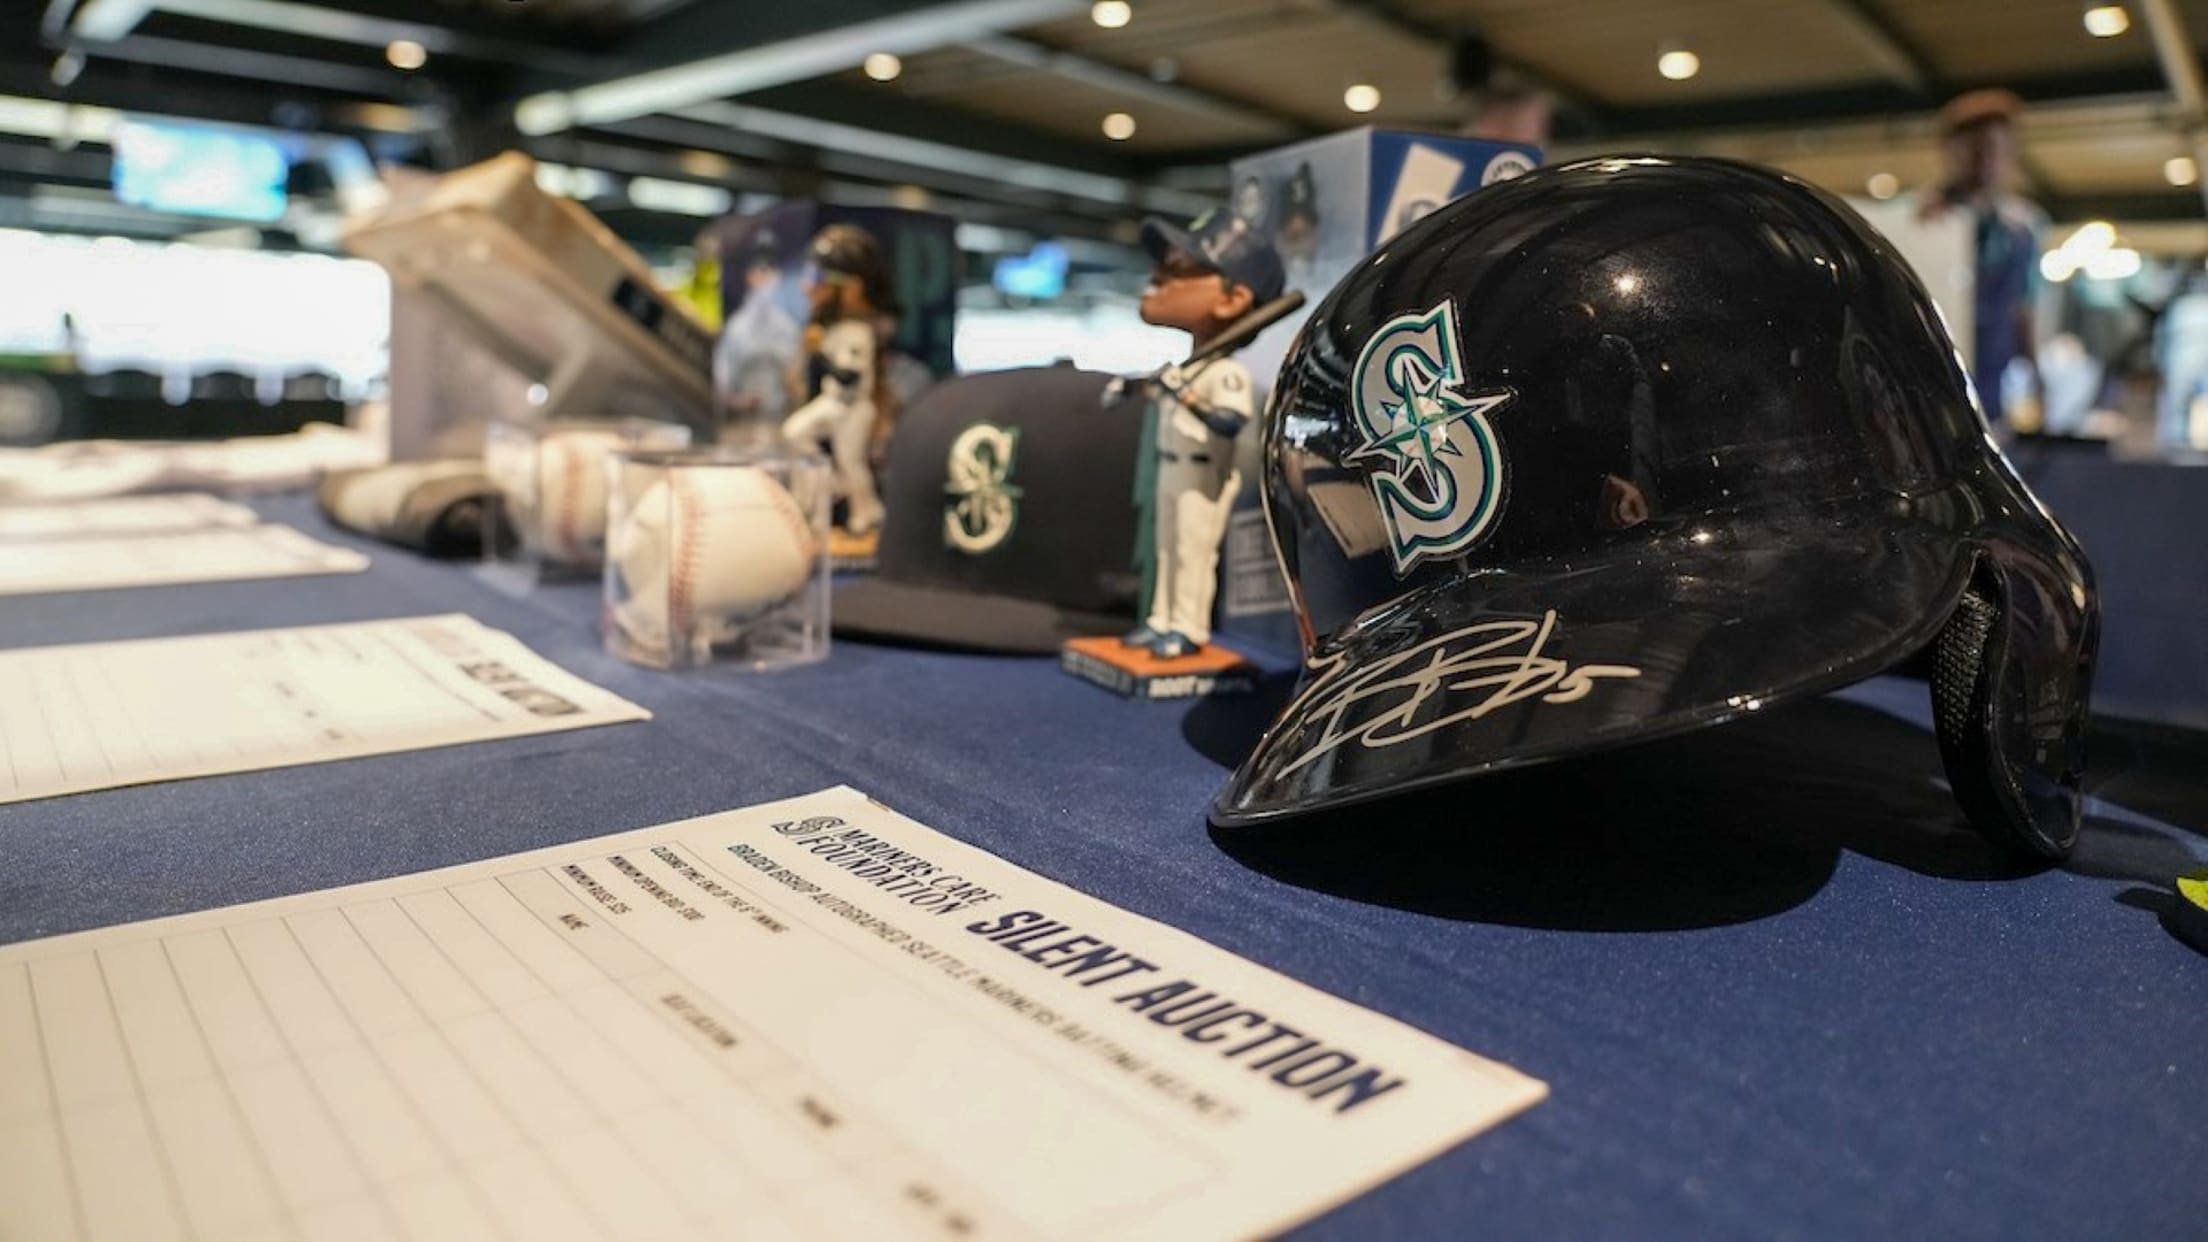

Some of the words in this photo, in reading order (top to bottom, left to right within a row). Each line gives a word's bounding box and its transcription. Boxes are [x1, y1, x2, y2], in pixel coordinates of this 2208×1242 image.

[727, 844, 783, 872] BRADEN
[768, 869, 822, 892] BISHOP
[808, 892, 912, 942] AUTOGRAPHED
[900, 940, 980, 978] SEATTLE
[796, 835, 969, 916] FOUNDATION
[833, 828, 942, 877] MARINERS
[929, 874, 1002, 906] CARE
[965, 910, 1161, 989] SILENT
[1113, 979, 1407, 1113] AUCTION
